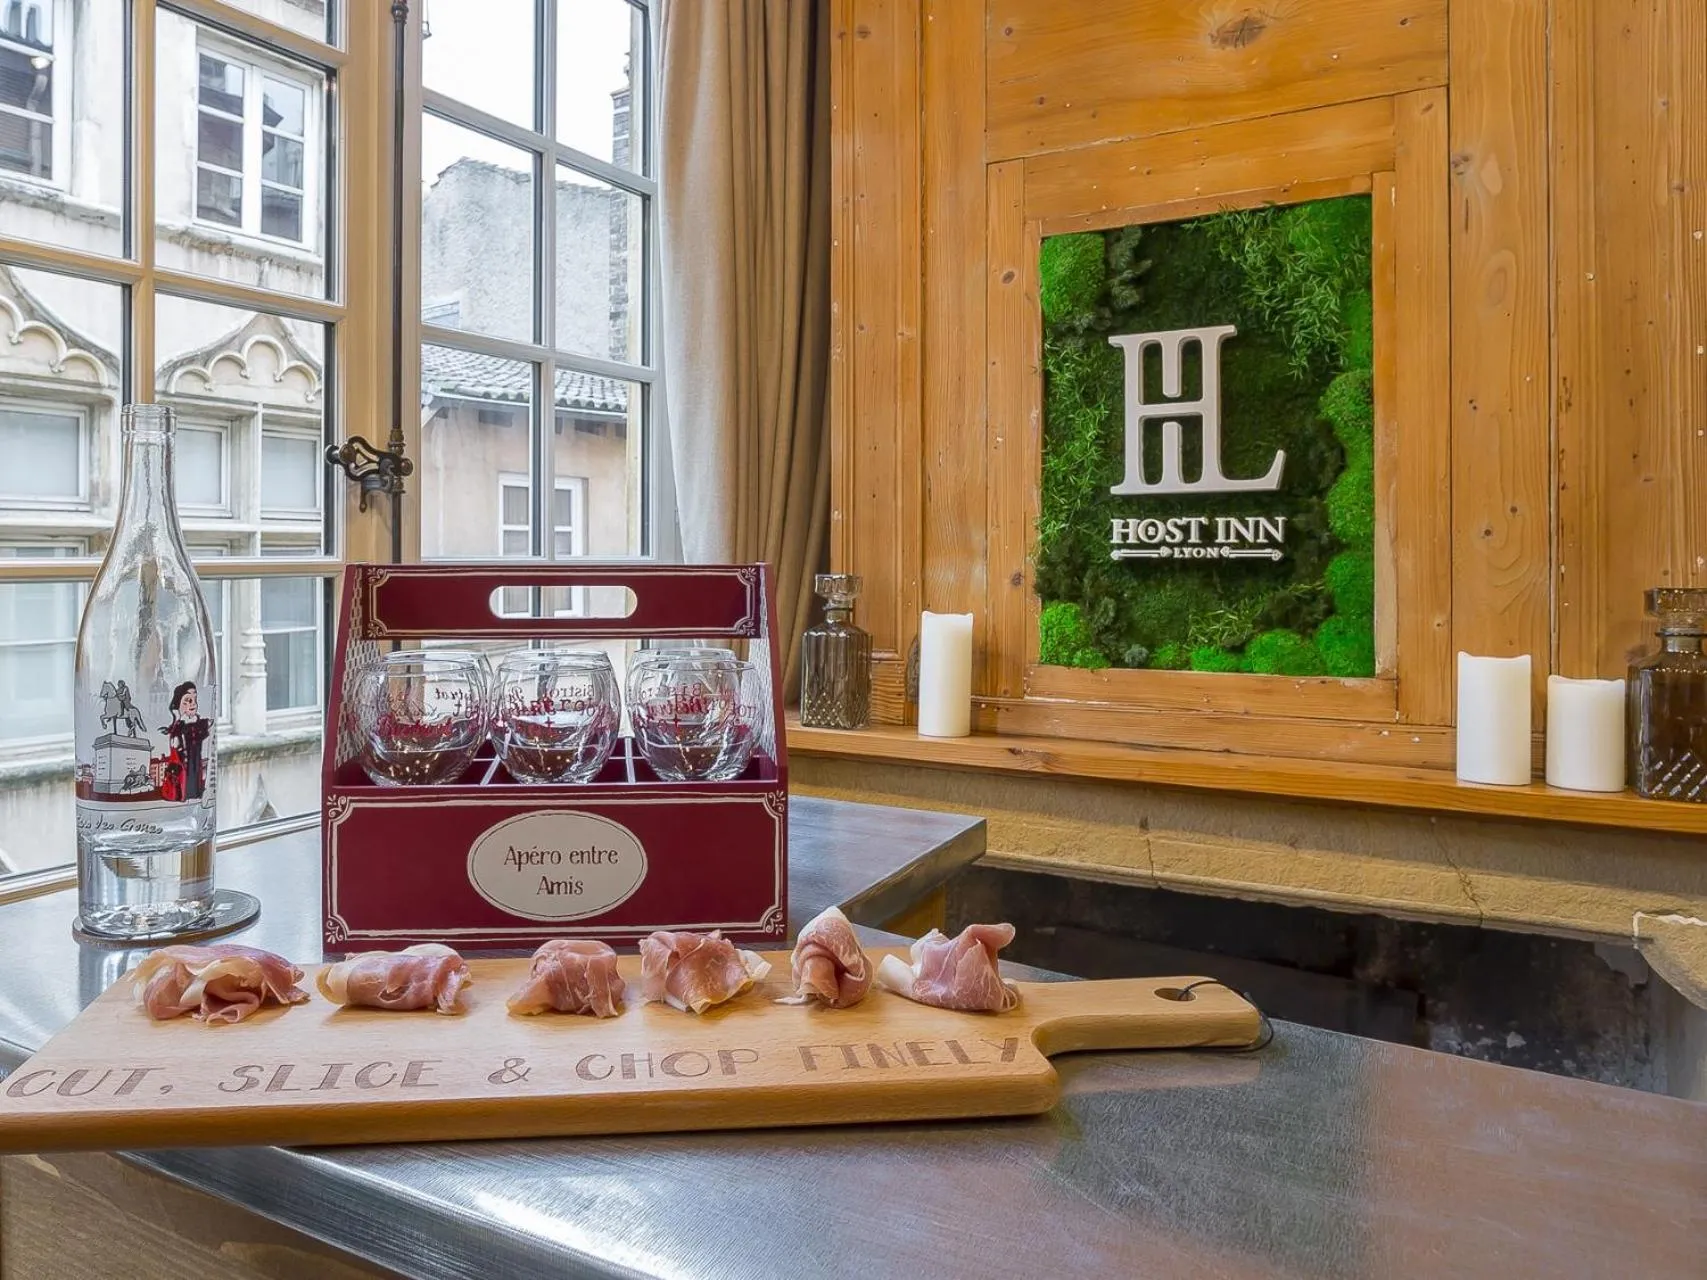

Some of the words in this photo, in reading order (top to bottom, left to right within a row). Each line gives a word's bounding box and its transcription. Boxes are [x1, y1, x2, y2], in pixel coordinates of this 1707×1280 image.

[1110, 516, 1209, 544] HOST
[1214, 516, 1287, 543] INN
[1173, 547, 1219, 559] LYON
[503, 845, 562, 872] Apéro
[569, 845, 619, 865] entre
[536, 875, 584, 895] Amis
[5, 1066, 175, 1098] CUT,
[217, 1059, 443, 1093] SLICE
[487, 1057, 533, 1085] &
[575, 1047, 760, 1082] CHOP
[798, 1037, 1019, 1072] FINELY
